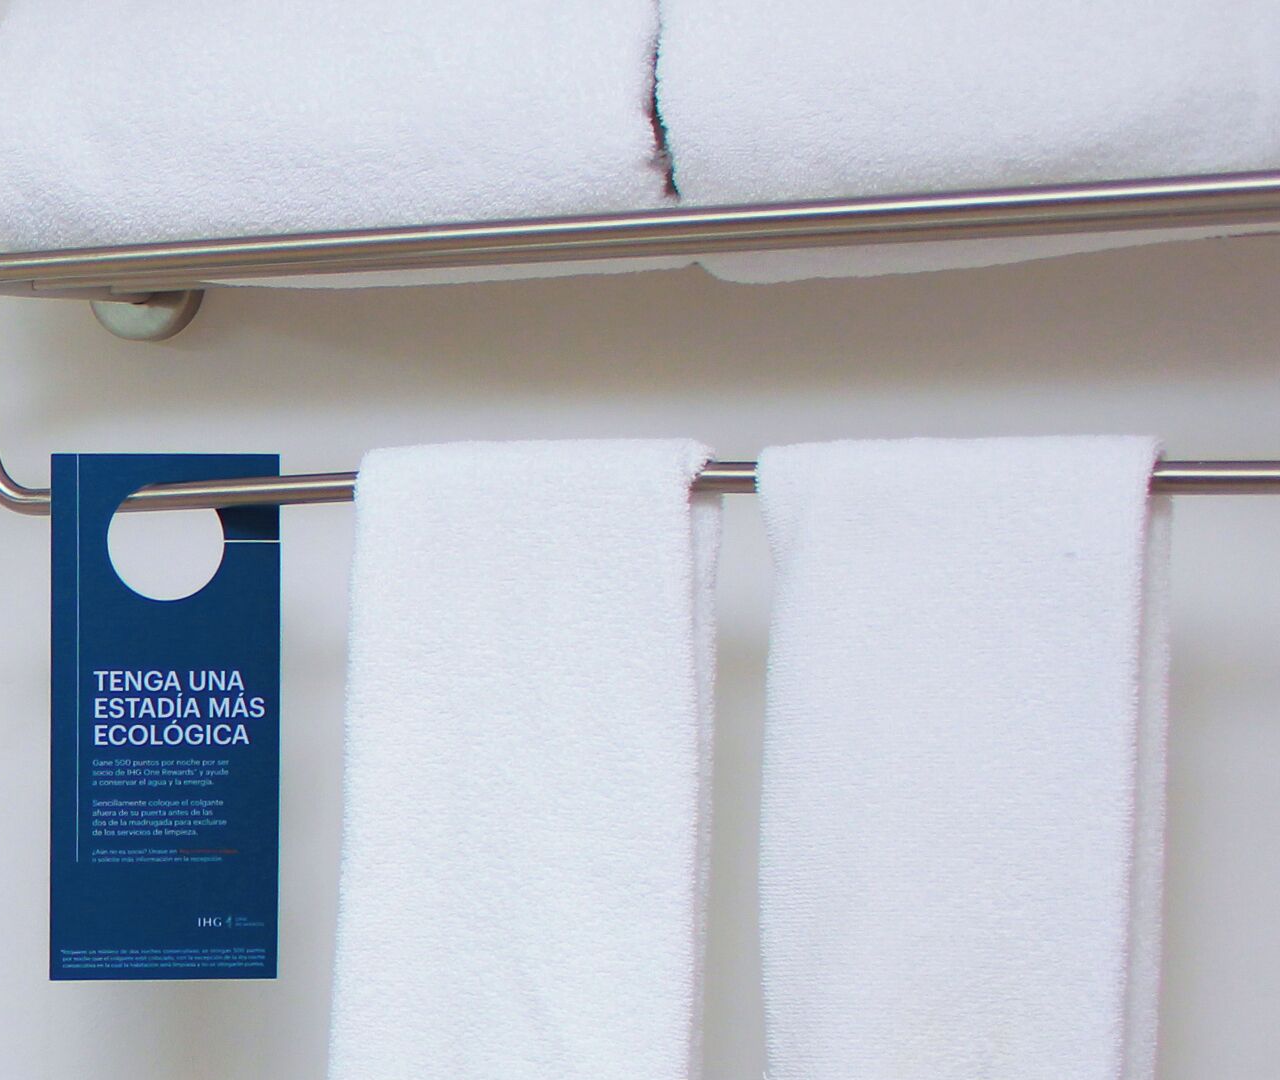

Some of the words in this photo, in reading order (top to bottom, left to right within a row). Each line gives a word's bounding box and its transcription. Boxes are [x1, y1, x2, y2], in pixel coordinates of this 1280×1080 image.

[93, 670, 181, 691] TENGA
[189, 670, 244, 691] UNA
[94, 692, 200, 718] ESTADÍA
[209, 692, 265, 718] MÁS
[94, 719, 250, 746] ECOLÓGICA
[176, 758, 200, 766] noche
[206, 768, 229, 777] ayude
[139, 778, 146, 786] el
[175, 778, 182, 786] la
[92, 799, 146, 807] Sencillamente
[148, 799, 180, 807] coloque
[190, 799, 224, 807] colgante
[92, 809, 117, 817] afuera
[118, 809, 129, 817] de
[141, 809, 167, 817] puerta
[202, 808, 213, 816] las
[128, 818, 173, 827] madrugada
[192, 818, 227, 826] excluirse
[104, 828, 116, 836] los
[164, 828, 198, 837] limpieza.
[198, 917, 222, 927] IHG
